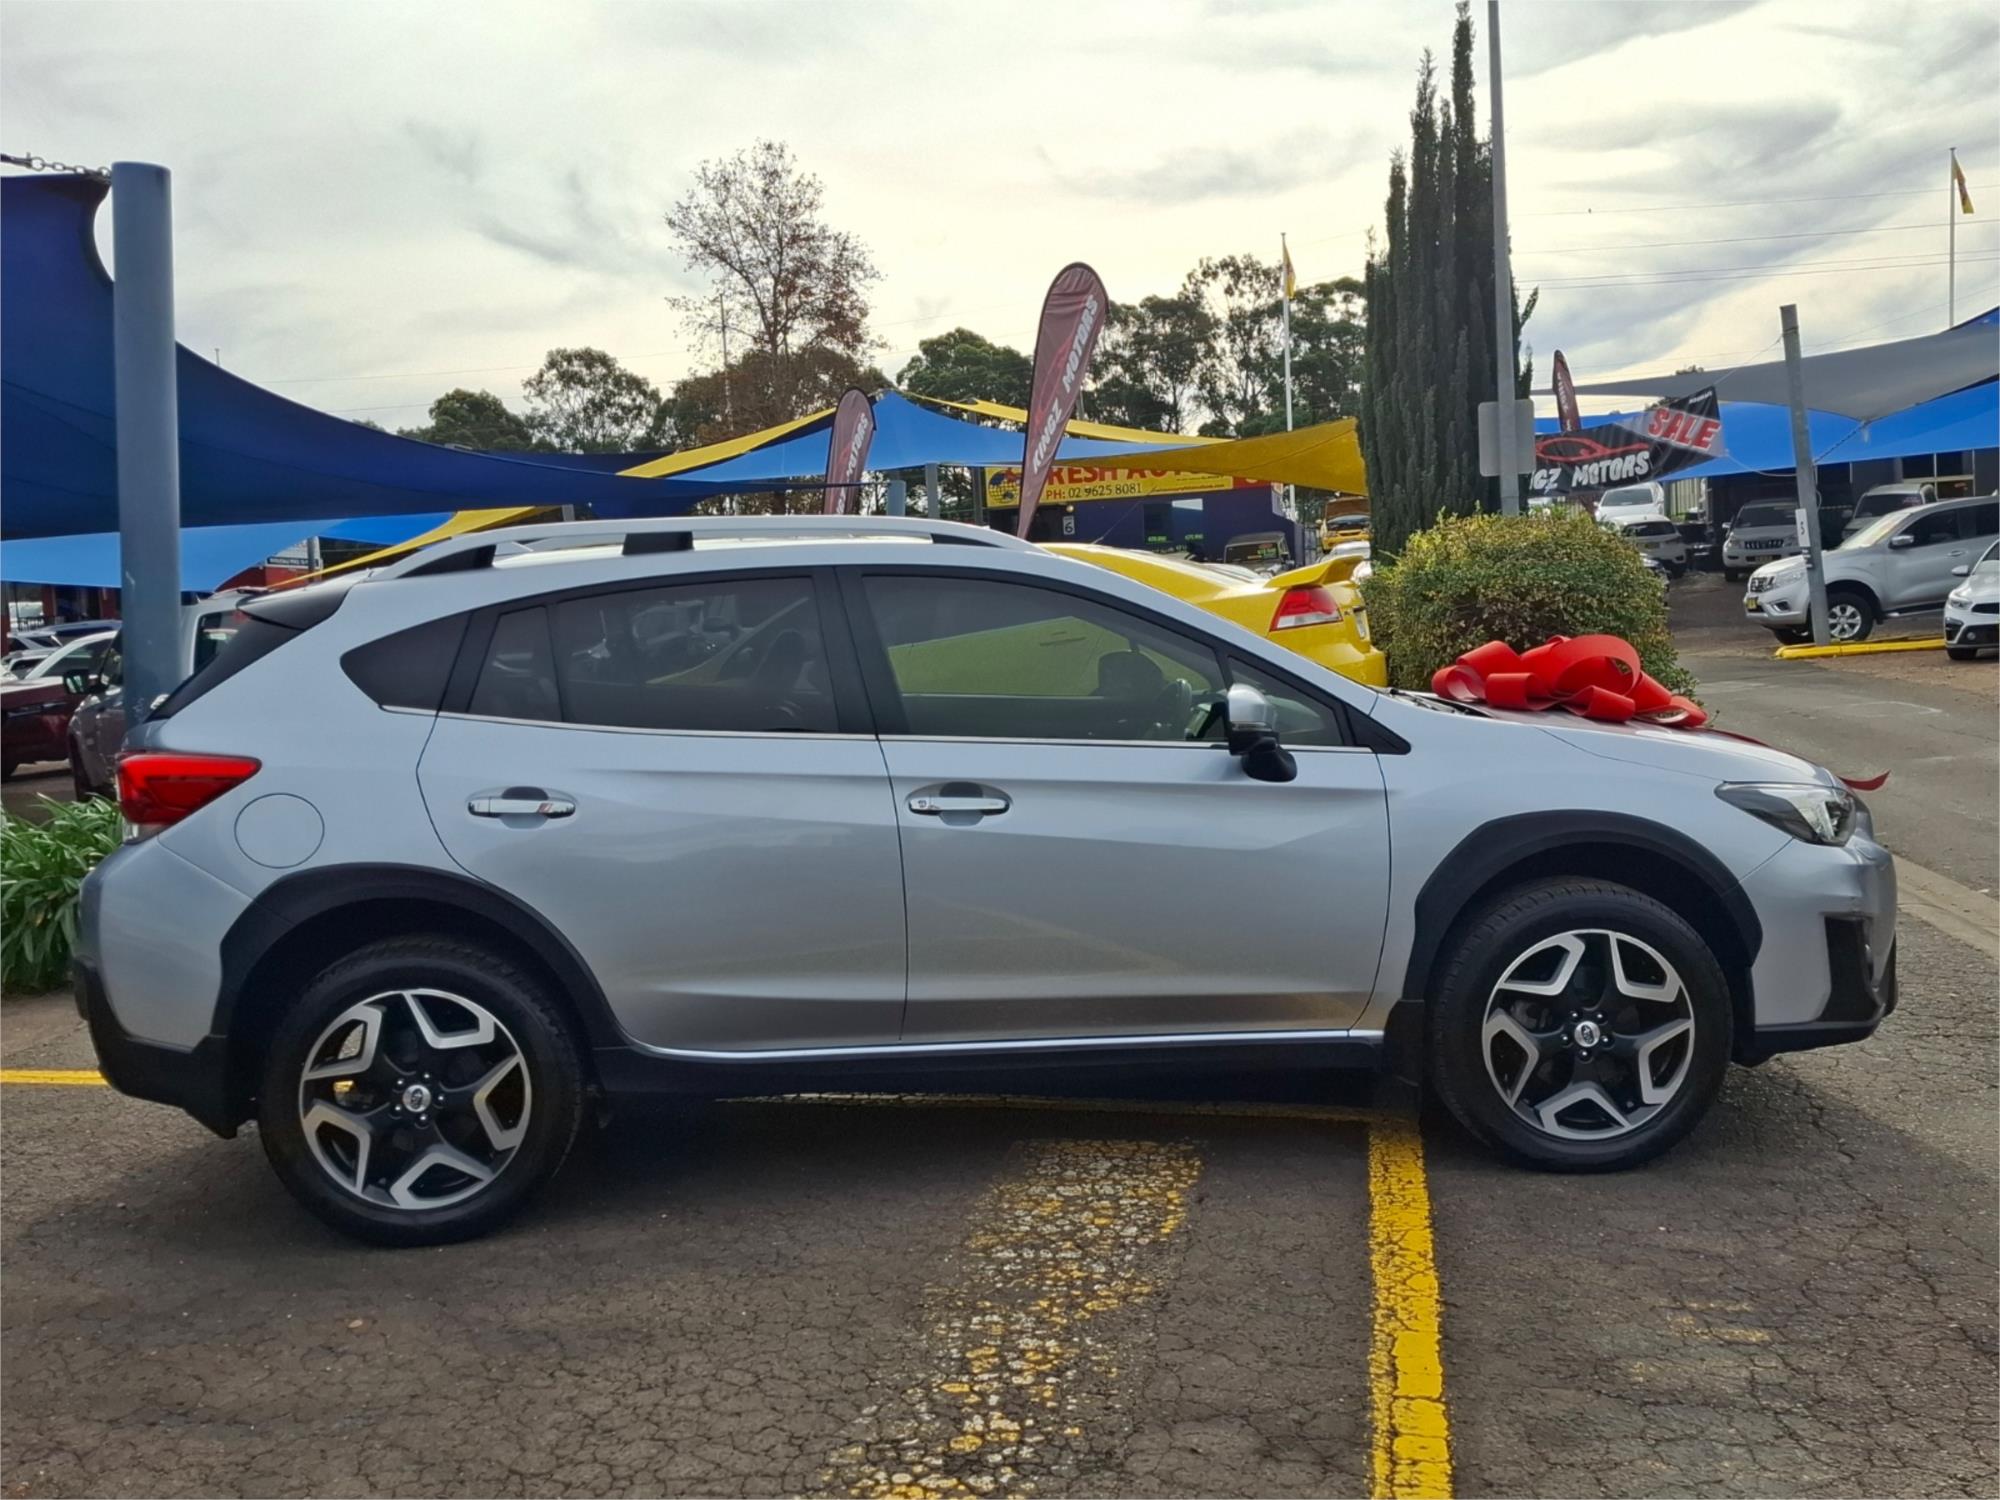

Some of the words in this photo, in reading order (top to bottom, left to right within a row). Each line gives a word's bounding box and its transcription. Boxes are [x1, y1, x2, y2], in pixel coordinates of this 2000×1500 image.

[1032, 397, 1062, 475] KINGZ
[1061, 294, 1099, 394] MOTORS
[1648, 407, 1721, 450] SALE
[1571, 450, 1650, 488] MOTORS
[1045, 489, 1066, 500] PH:
[1068, 487, 1081, 499] 02
[1084, 484, 1112, 497] 9625
[1115, 482, 1142, 495] 8081
[1065, 521, 1073, 533] 6
